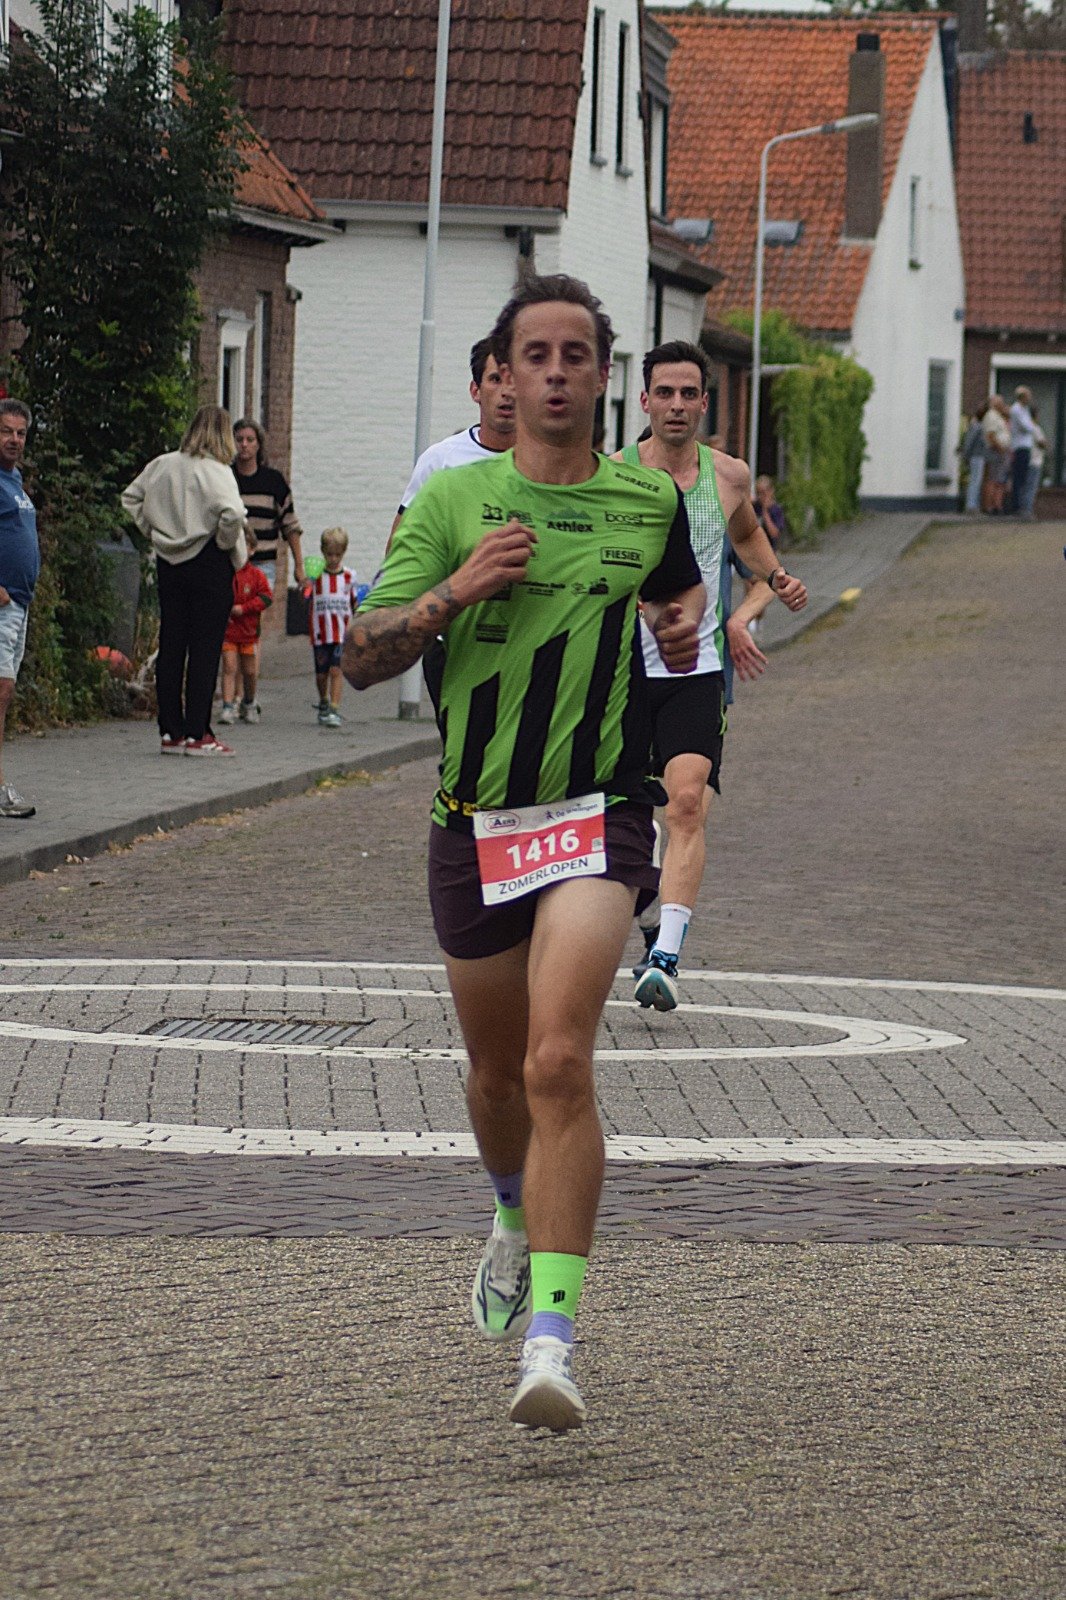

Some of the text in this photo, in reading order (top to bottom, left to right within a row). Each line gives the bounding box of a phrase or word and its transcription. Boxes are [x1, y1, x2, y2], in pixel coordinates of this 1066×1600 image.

[547, 520, 594, 533] Athlex
[507, 829, 580, 870] 1416
[498, 857, 589, 895] ZOMERLOPEN
